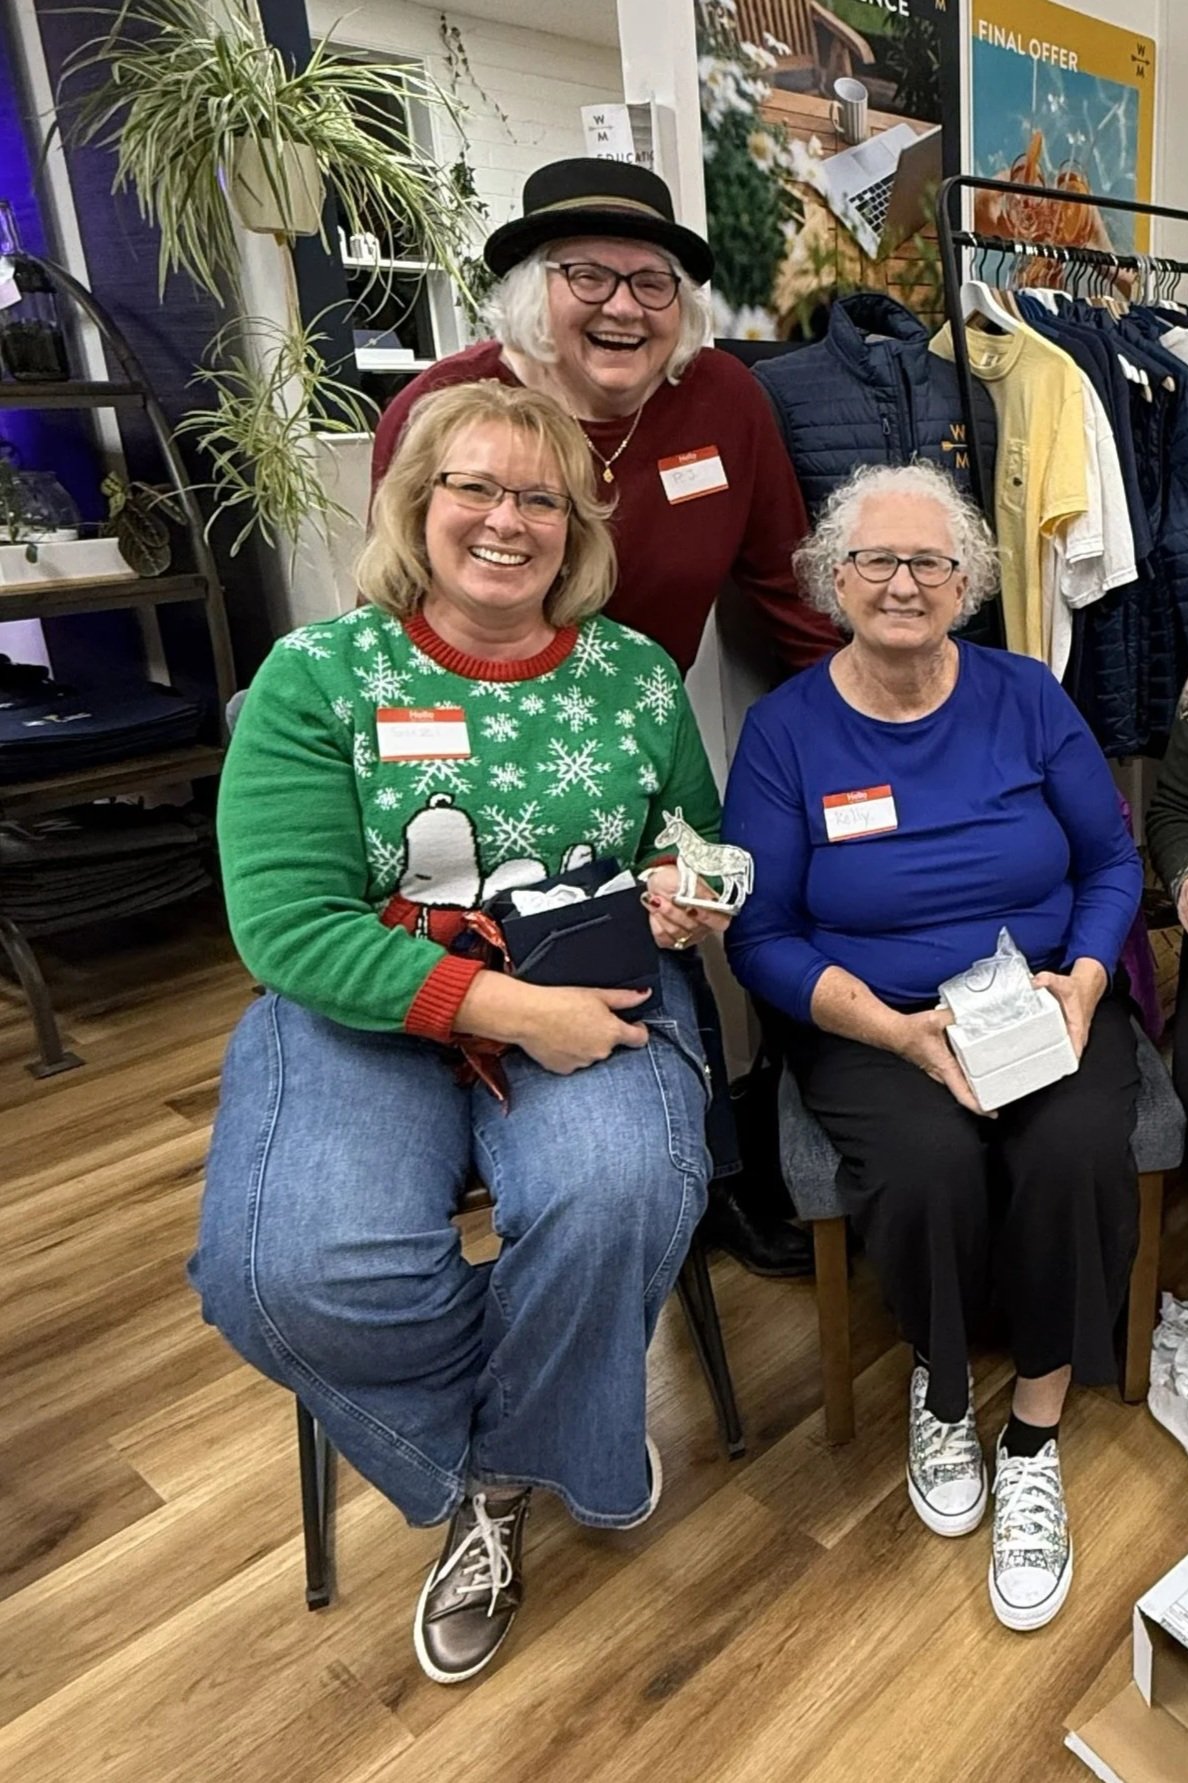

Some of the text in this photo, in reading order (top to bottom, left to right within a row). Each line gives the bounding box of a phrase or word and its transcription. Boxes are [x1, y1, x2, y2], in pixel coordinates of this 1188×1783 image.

[978, 19, 1079, 73] FINAL OFFER
[1136, 43, 1146, 57] W
[1136, 66, 1145, 79] M
[593, 114, 605, 125] W
[597, 131, 609, 142] M
[949, 424, 966, 441] W
[955, 451, 970, 469] M
